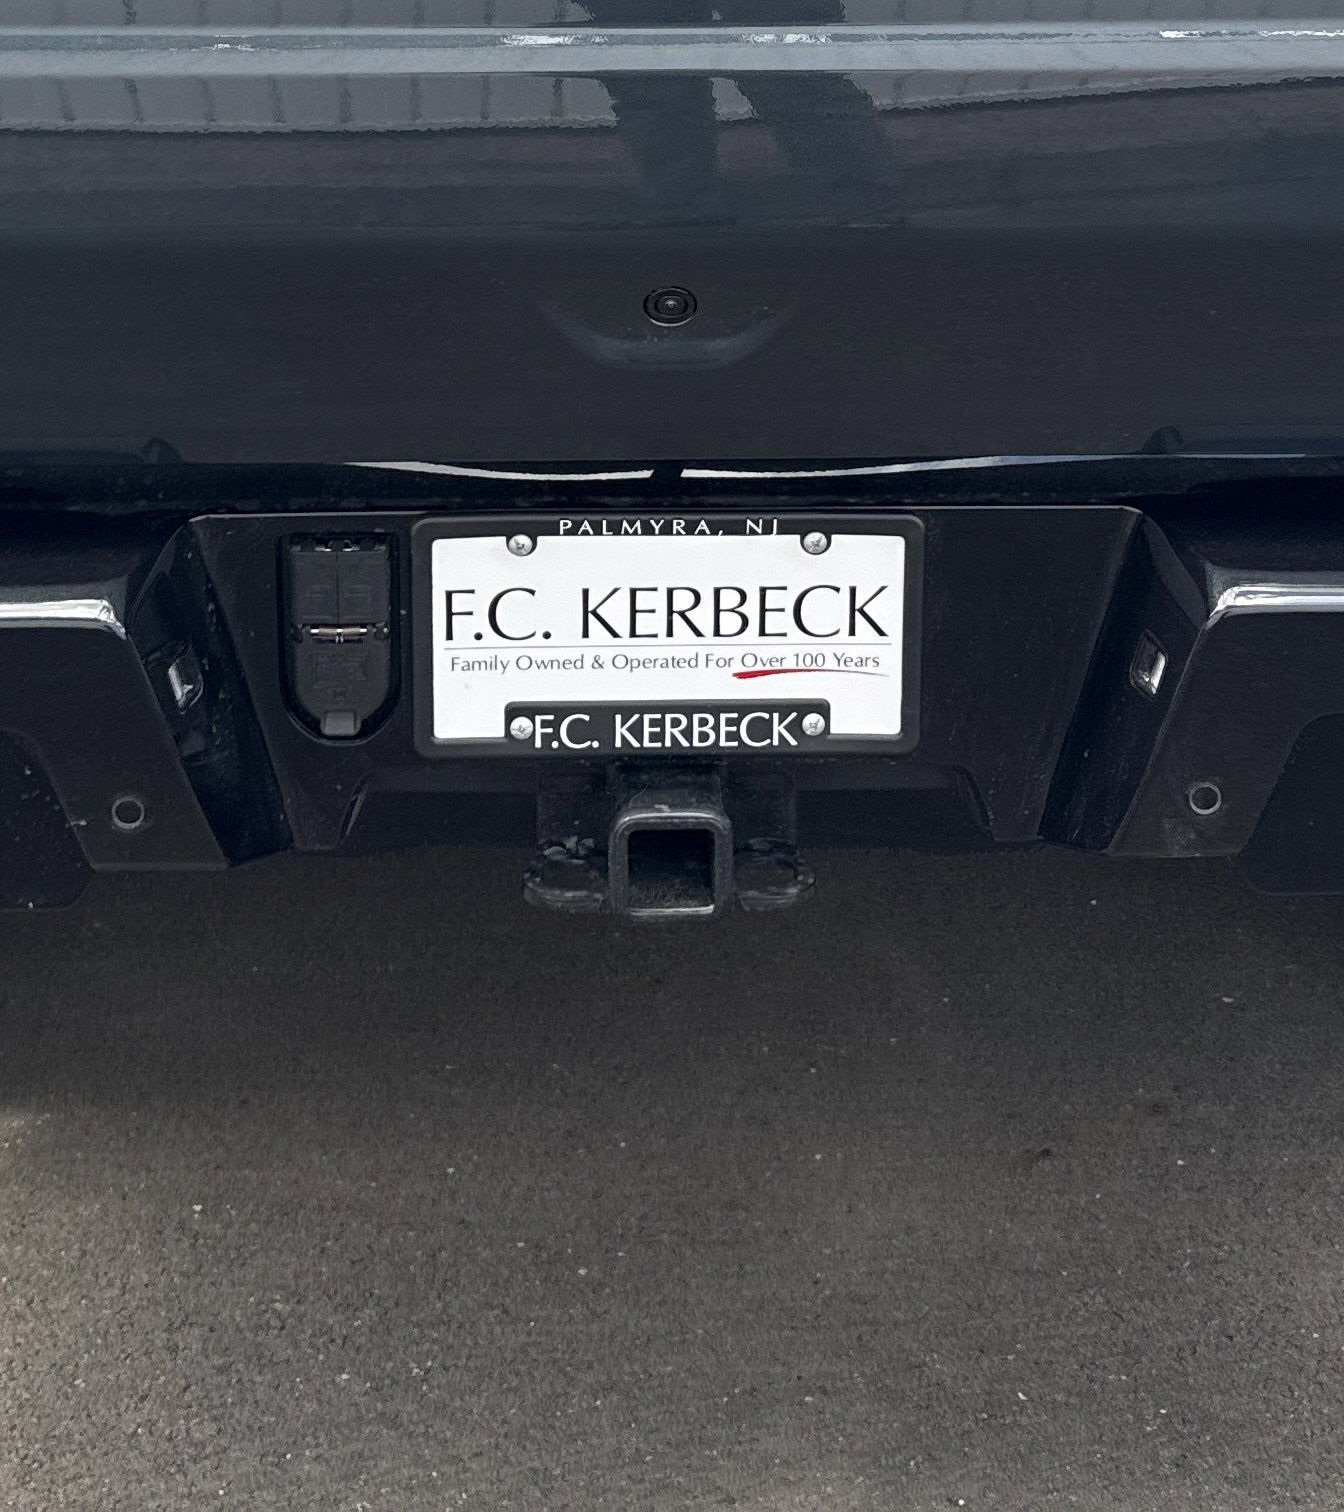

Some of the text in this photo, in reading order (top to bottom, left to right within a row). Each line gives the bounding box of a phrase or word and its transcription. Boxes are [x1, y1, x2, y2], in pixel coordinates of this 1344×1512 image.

[558, 519, 778, 536] PALMYRA, NJ
[444, 584, 889, 641] F.C. KERBECK
[450, 651, 881, 675] Family Owned & Operated For Over 100 Years
[534, 711, 799, 749] F.C. KERBECK
